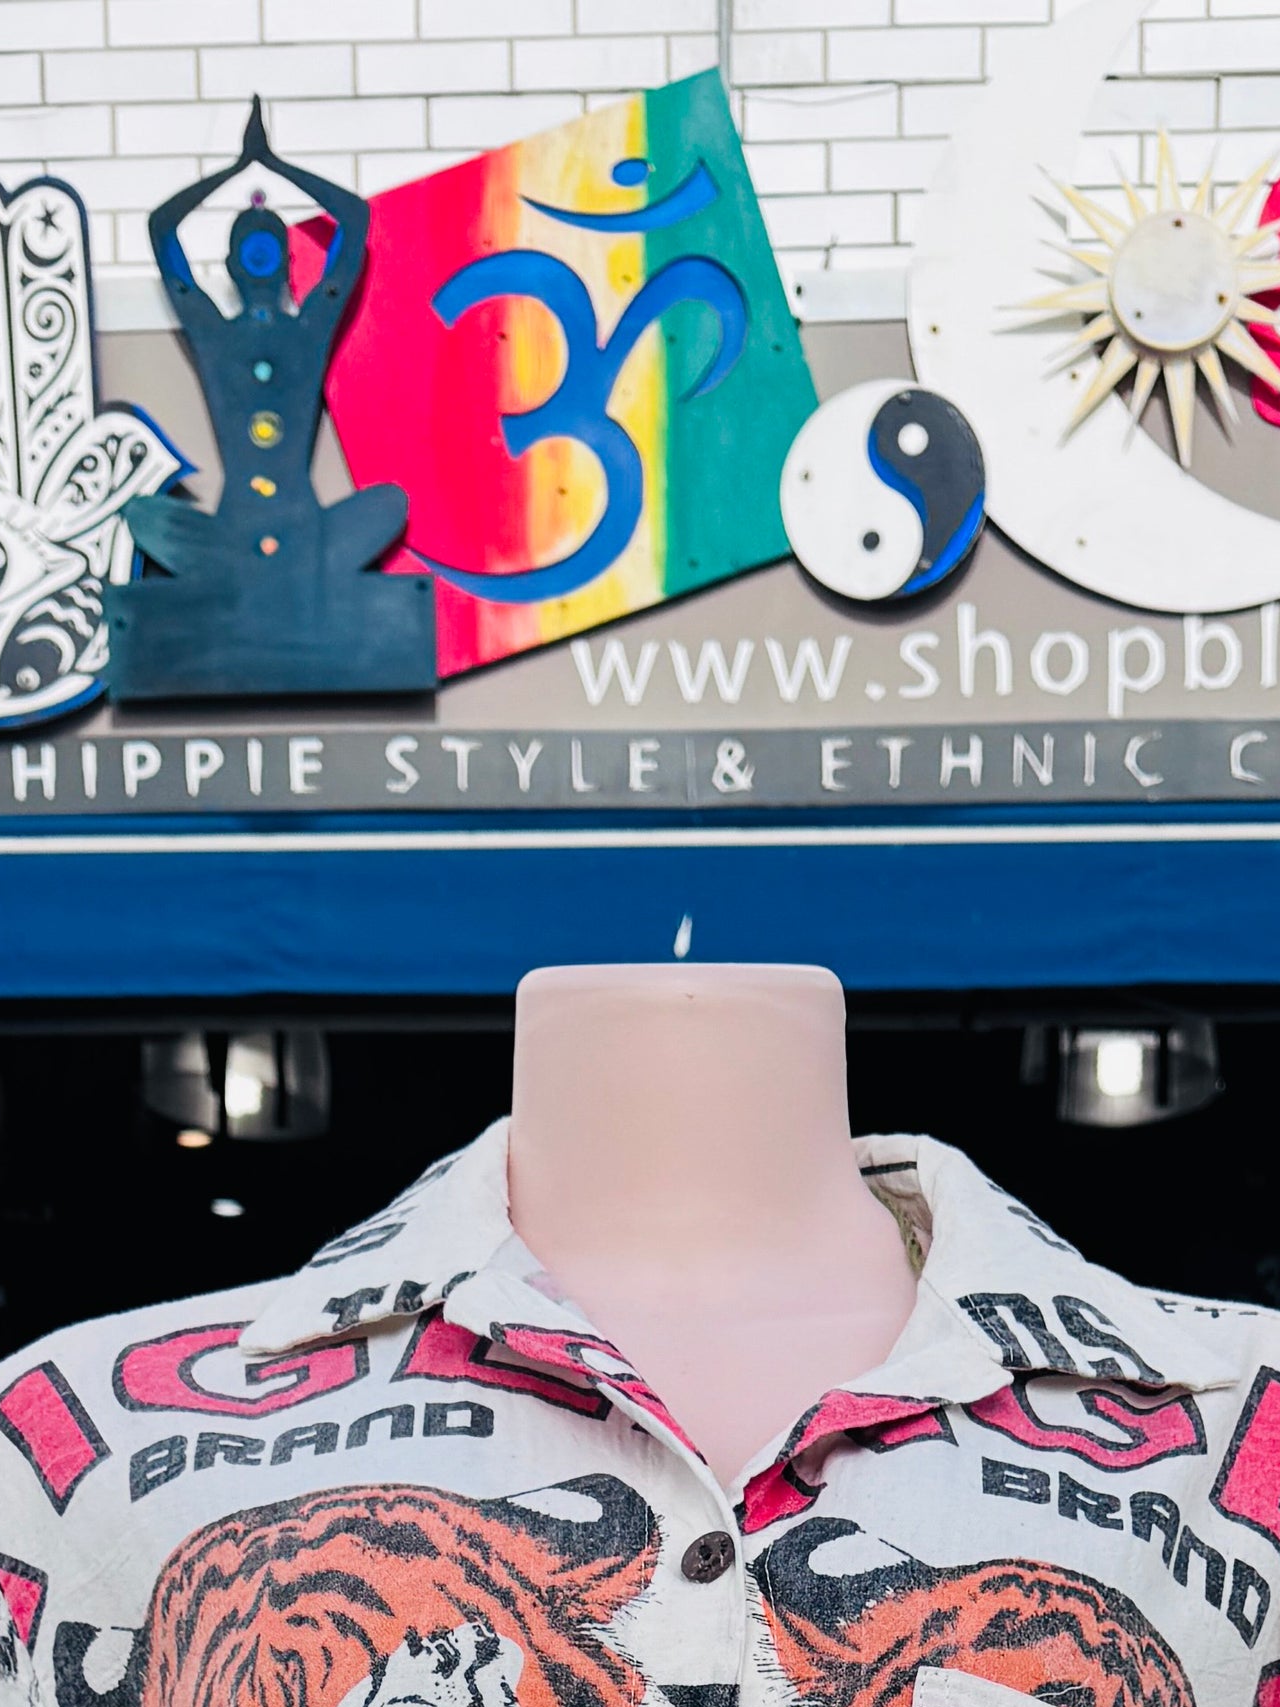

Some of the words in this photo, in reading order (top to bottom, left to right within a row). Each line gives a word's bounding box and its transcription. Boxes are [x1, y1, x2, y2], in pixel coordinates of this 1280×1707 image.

[11, 732, 323, 802] HIPPIE
[384, 737, 661, 794] STYLE
[710, 739, 756, 795] &
[820, 731, 1162, 792] ETHNIC
[129, 1400, 495, 1502] BRAND
[980, 1456, 1271, 1649] BRAND
